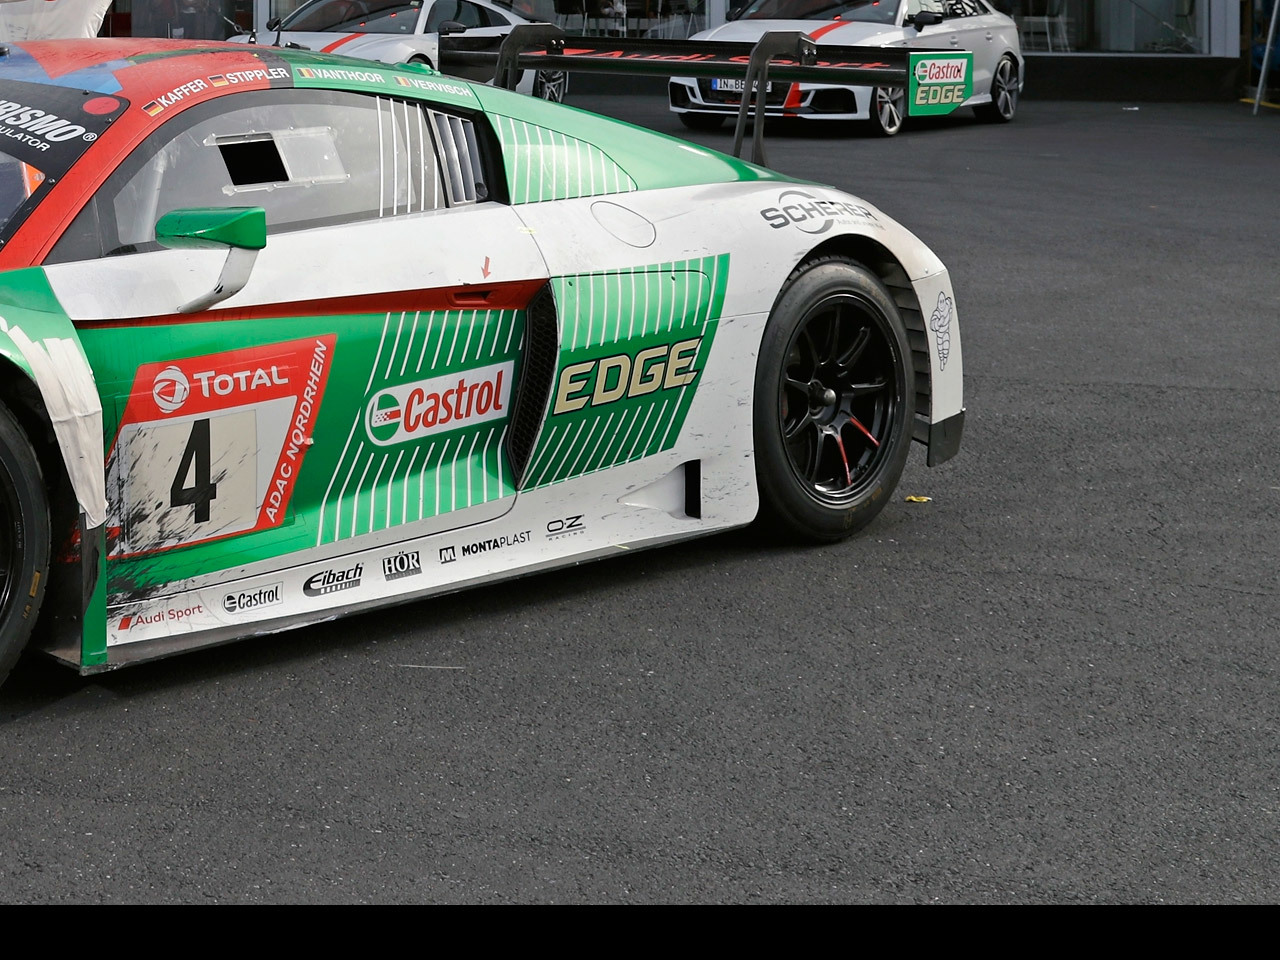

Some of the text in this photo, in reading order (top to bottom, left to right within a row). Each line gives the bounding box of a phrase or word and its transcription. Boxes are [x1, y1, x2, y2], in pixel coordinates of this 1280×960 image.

[226, 66, 290, 84] STIPPLER
[312, 68, 385, 83] VANTHOOR
[927, 61, 964, 80] Castrol
[158, 77, 208, 108] KAFFER
[408, 77, 473, 98] VERVISCH
[915, 84, 966, 105] EDGE
[759, 201, 879, 229] SCHERER
[193, 365, 289, 398] TOTAL
[552, 336, 702, 416] EDGE
[404, 369, 504, 435] Castrol
[265, 339, 328, 524] ADAC NORDRHEIN
[170, 418, 217, 524] 4
[461, 530, 532, 557] MONTAPLAST
[549, 530, 584, 541] RACING
[384, 551, 420, 576] HÖR
[303, 563, 364, 597] Eibach
[238, 584, 280, 610] Castrol
[135, 604, 204, 626] Audi Sport
